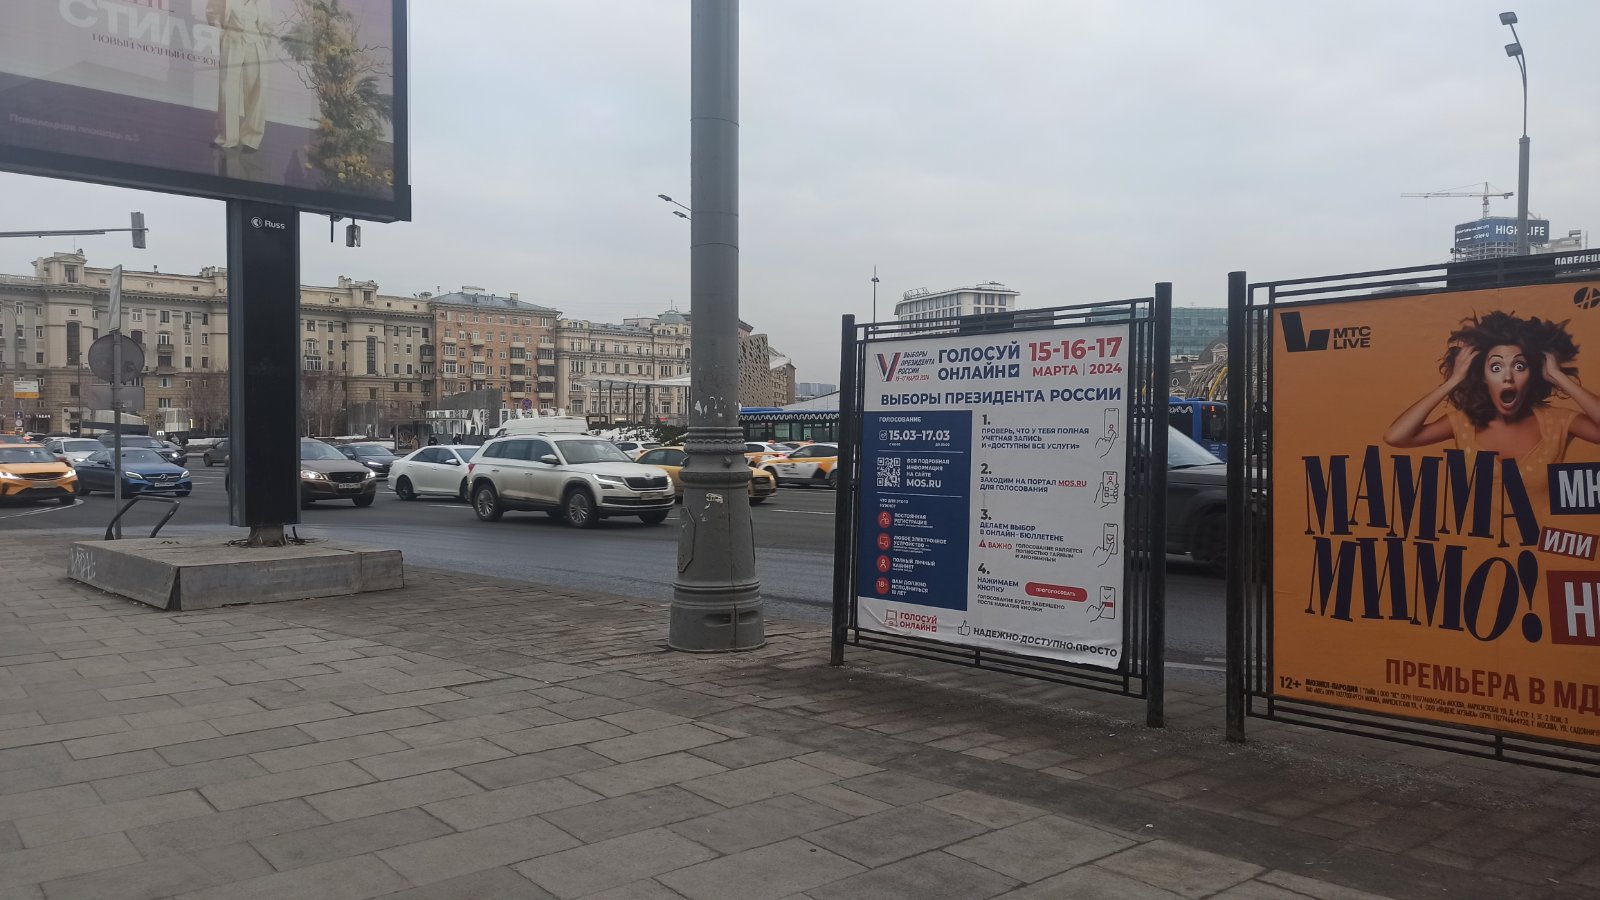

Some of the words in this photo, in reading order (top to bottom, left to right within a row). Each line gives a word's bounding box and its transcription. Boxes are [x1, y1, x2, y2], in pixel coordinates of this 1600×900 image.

[60, 0, 220, 57] СТИЛЯ
[265, 220, 285, 229] Russ
[1333, 326, 1371, 338] МТС
[1029, 336, 1122, 362] 15-16-17
[1333, 338, 1371, 349] LIVE
[939, 341, 1020, 363] ГОЛОСУЙ
[938, 362, 1006, 380] ОНЛАЙН
[1033, 365, 1078, 377] МАРТА
[1090, 363, 1122, 375] 2024
[881, 393, 941, 405] ВЫБОРЫ
[945, 390, 1045, 406] ПРЕЗИДЕНТА
[1050, 388, 1120, 402] РОССИИ
[982, 414, 991, 425] 1.
[981, 463, 992, 474] 2.
[907, 479, 941, 488] MOS.RU
[997, 485, 1048, 493] ГОЛОСОВАНИЯ
[1058, 480, 1087, 488] MOS.RU
[1302, 445, 1539, 548] МАММА
[981, 509, 992, 520] 3.
[980, 522, 1009, 530] ДЕЛАЕМ
[986, 529, 1064, 542] ОНЛАЙН-БЮЛЛЕТЕНЕ
[988, 542, 1012, 550] ВАЖНО
[1015, 543, 1054, 551] ГОЛОСОВАНИЕ
[1545, 530, 1592, 558] ИЛИ
[978, 563, 990, 574] 4.
[977, 577, 1019, 587] НАЖИМАЕМ
[977, 585, 1005, 593] КНОПКУ
[1305, 537, 1542, 643] МИМО!
[900, 612, 937, 625] ГОЛОСУЙ
[900, 621, 930, 632] ОНЛАЙН
[1280, 676, 1301, 690] 12+
[1386, 658, 1520, 702] ПРЕМЬЕРА
[1528, 677, 1545, 705] В
